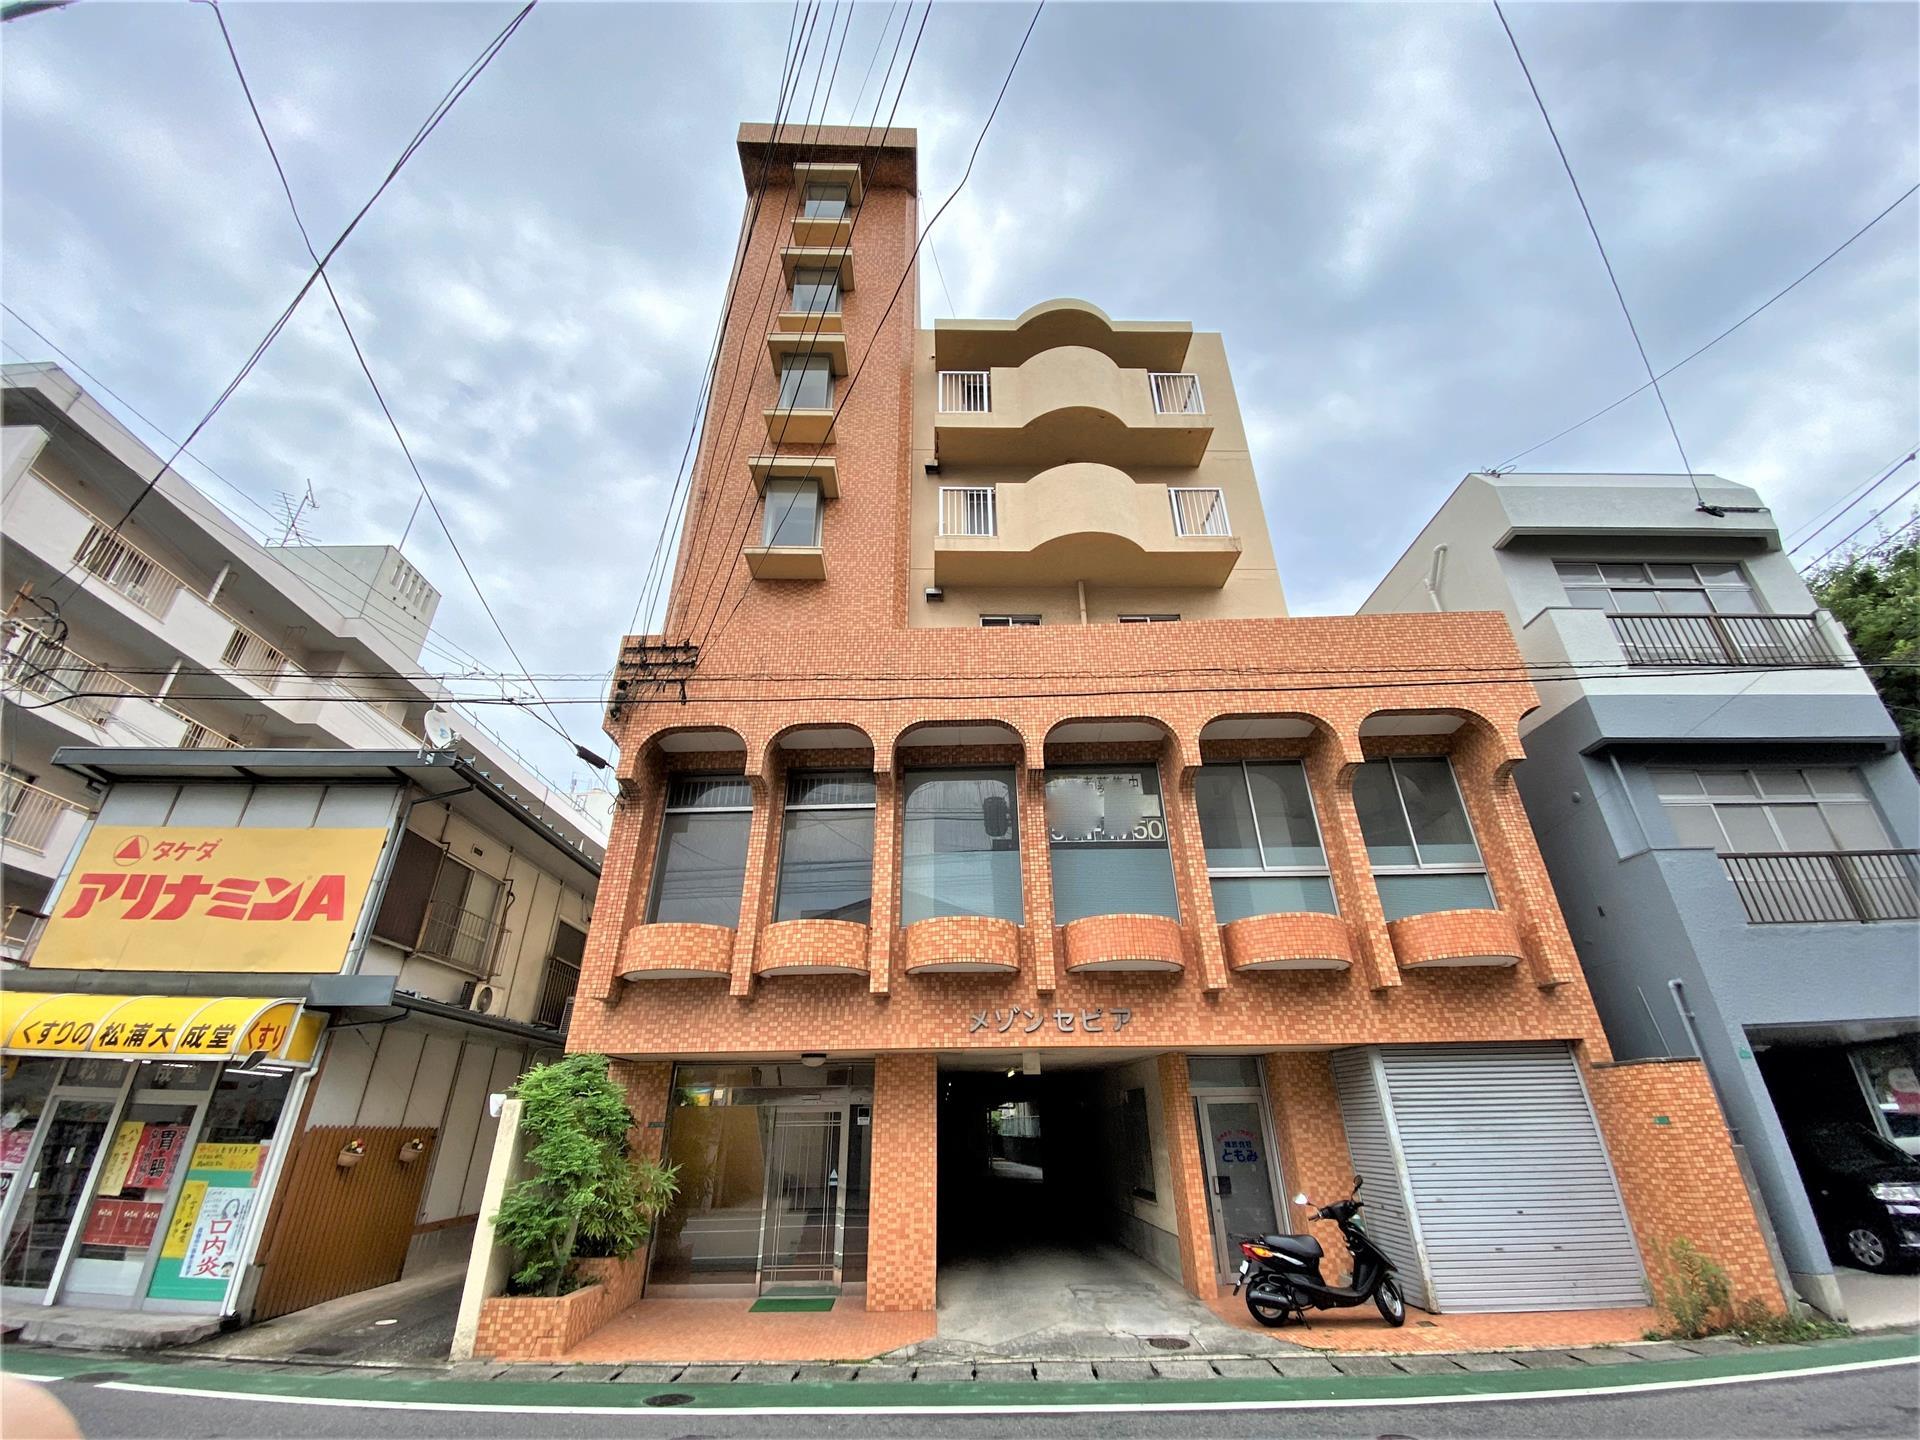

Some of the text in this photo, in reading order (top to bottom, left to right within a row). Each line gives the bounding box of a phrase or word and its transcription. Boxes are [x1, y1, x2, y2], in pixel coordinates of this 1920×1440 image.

[153, 838, 223, 862] タケダ
[61, 873, 346, 921] アリナミンA
[969, 1005, 1132, 1033] メゾンセピア
[247, 1021, 288, 1051] くすり
[1222, 1149, 1258, 1163] ともみ
[192, 1218, 232, 1277] 口内炎
